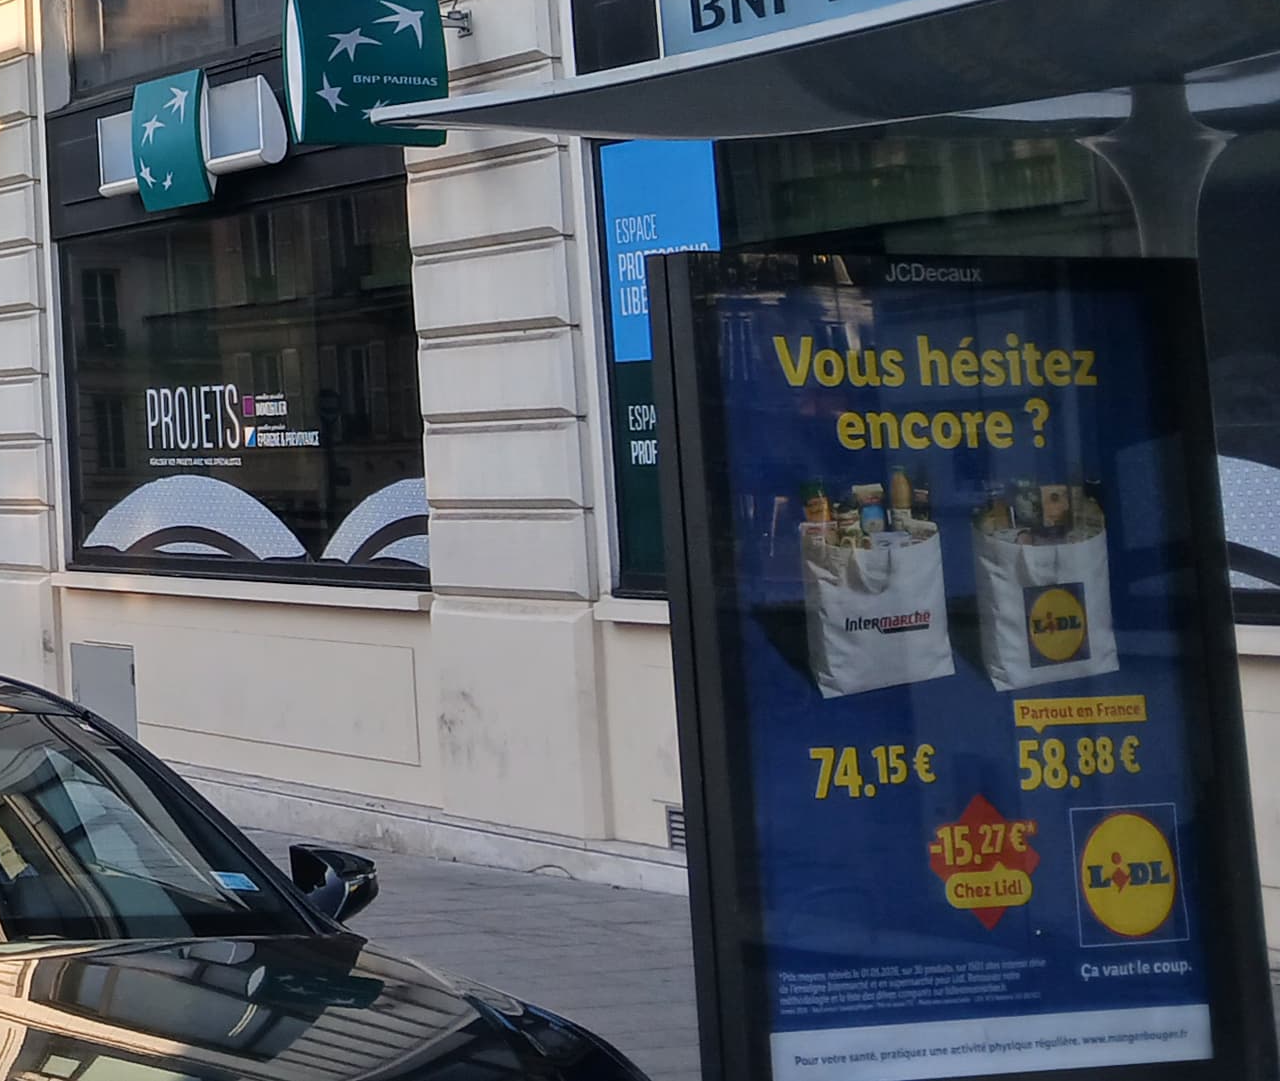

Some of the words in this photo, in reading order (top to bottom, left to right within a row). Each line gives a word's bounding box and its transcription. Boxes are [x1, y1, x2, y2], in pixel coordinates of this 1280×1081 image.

[352, 74, 380, 84] BNP
[383, 75, 438, 87] PARIBAS
[615, 213, 658, 244] ESPACE
[885, 263, 983, 283] JCDecaux
[772, 335, 905, 388] Vous
[916, 333, 1098, 387] hésitez
[146, 383, 240, 450] PROJETS
[836, 409, 1014, 450] encore
[1020, 704, 1074, 720] Partout
[1076, 705, 1093, 719] en
[1096, 702, 1142, 716] France
[954, 882, 991, 899] Chez
[995, 879, 1024, 896] Lidl
[1081, 963, 1099, 982] Ça
[1102, 961, 1134, 977] vaut
[1137, 960, 1150, 974] le
[1153, 961, 1192, 976] coup.
[795, 1055, 819, 1066] Pour
[821, 1054, 847, 1065] votre
[880, 1048, 927, 1062] pratiquez
[929, 1047, 948, 1056] une
[950, 1041, 986, 1055] activité
